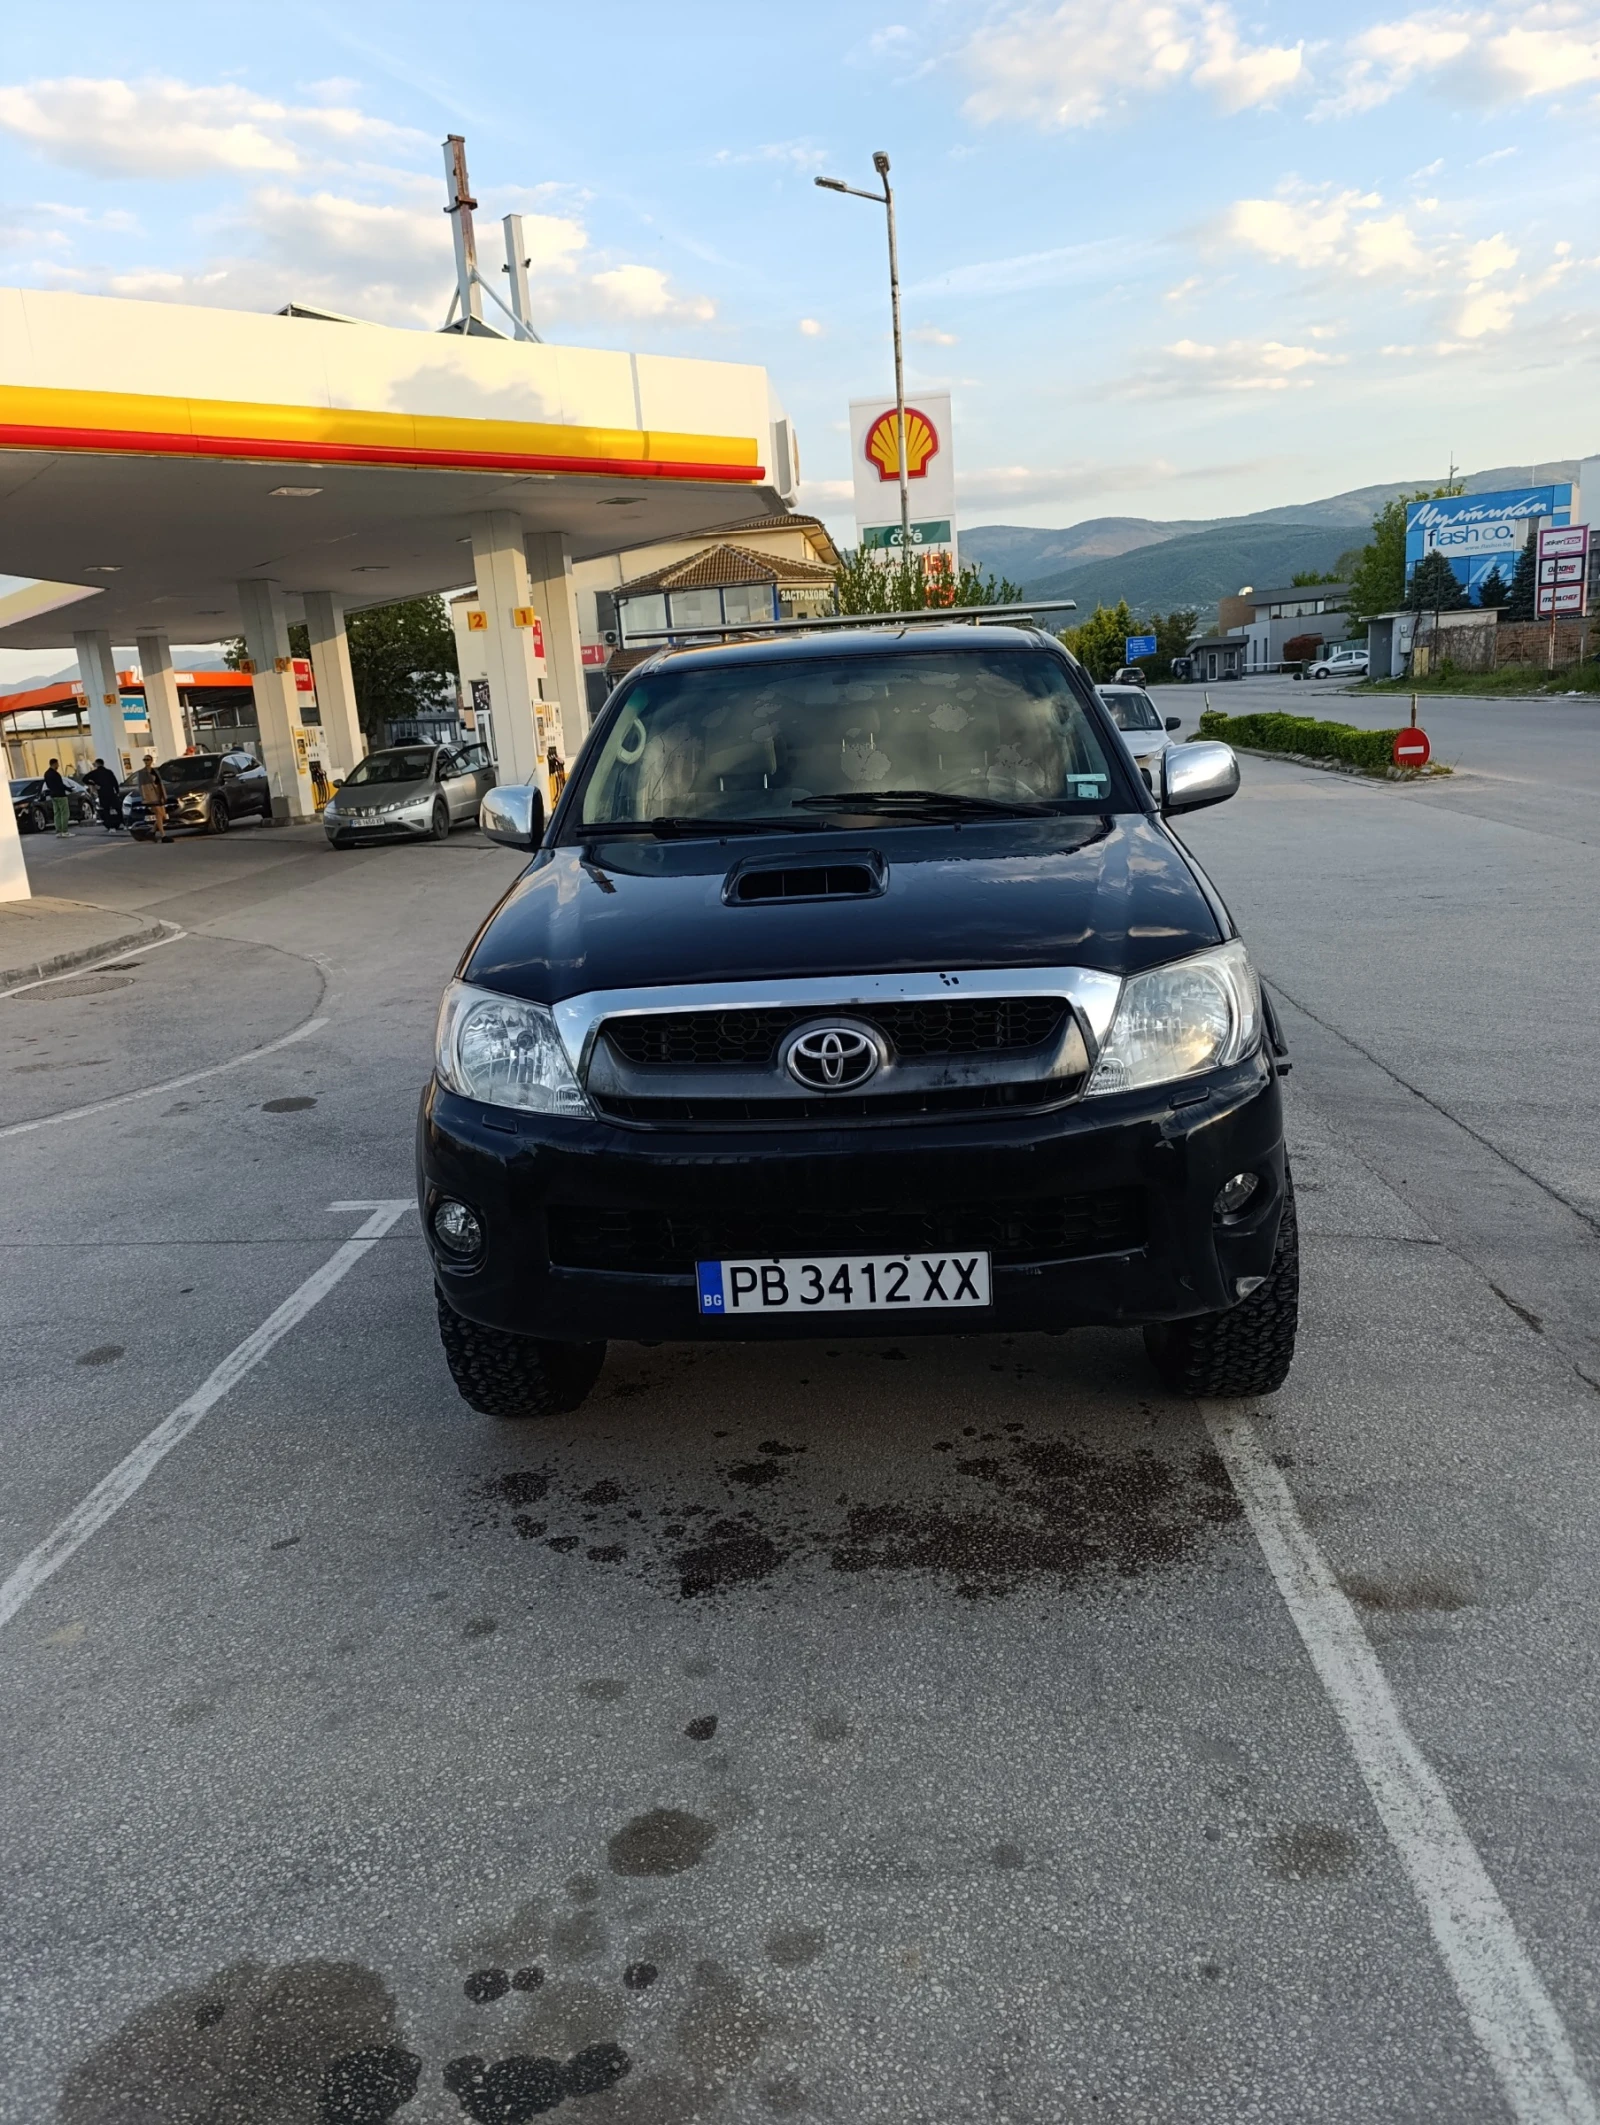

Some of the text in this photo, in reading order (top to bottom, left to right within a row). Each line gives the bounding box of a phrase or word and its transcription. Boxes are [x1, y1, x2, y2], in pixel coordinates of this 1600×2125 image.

[1427, 525, 1514, 547] flash co.
[780, 589, 832, 601] ЗАСТРАХОВК
[472, 614, 483, 628] 2
[519, 610, 527, 624] 1
[242, 661, 251, 672] 4
[730, 1257, 980, 1307] PB 3412 XX
[703, 1294, 722, 1307] BG
